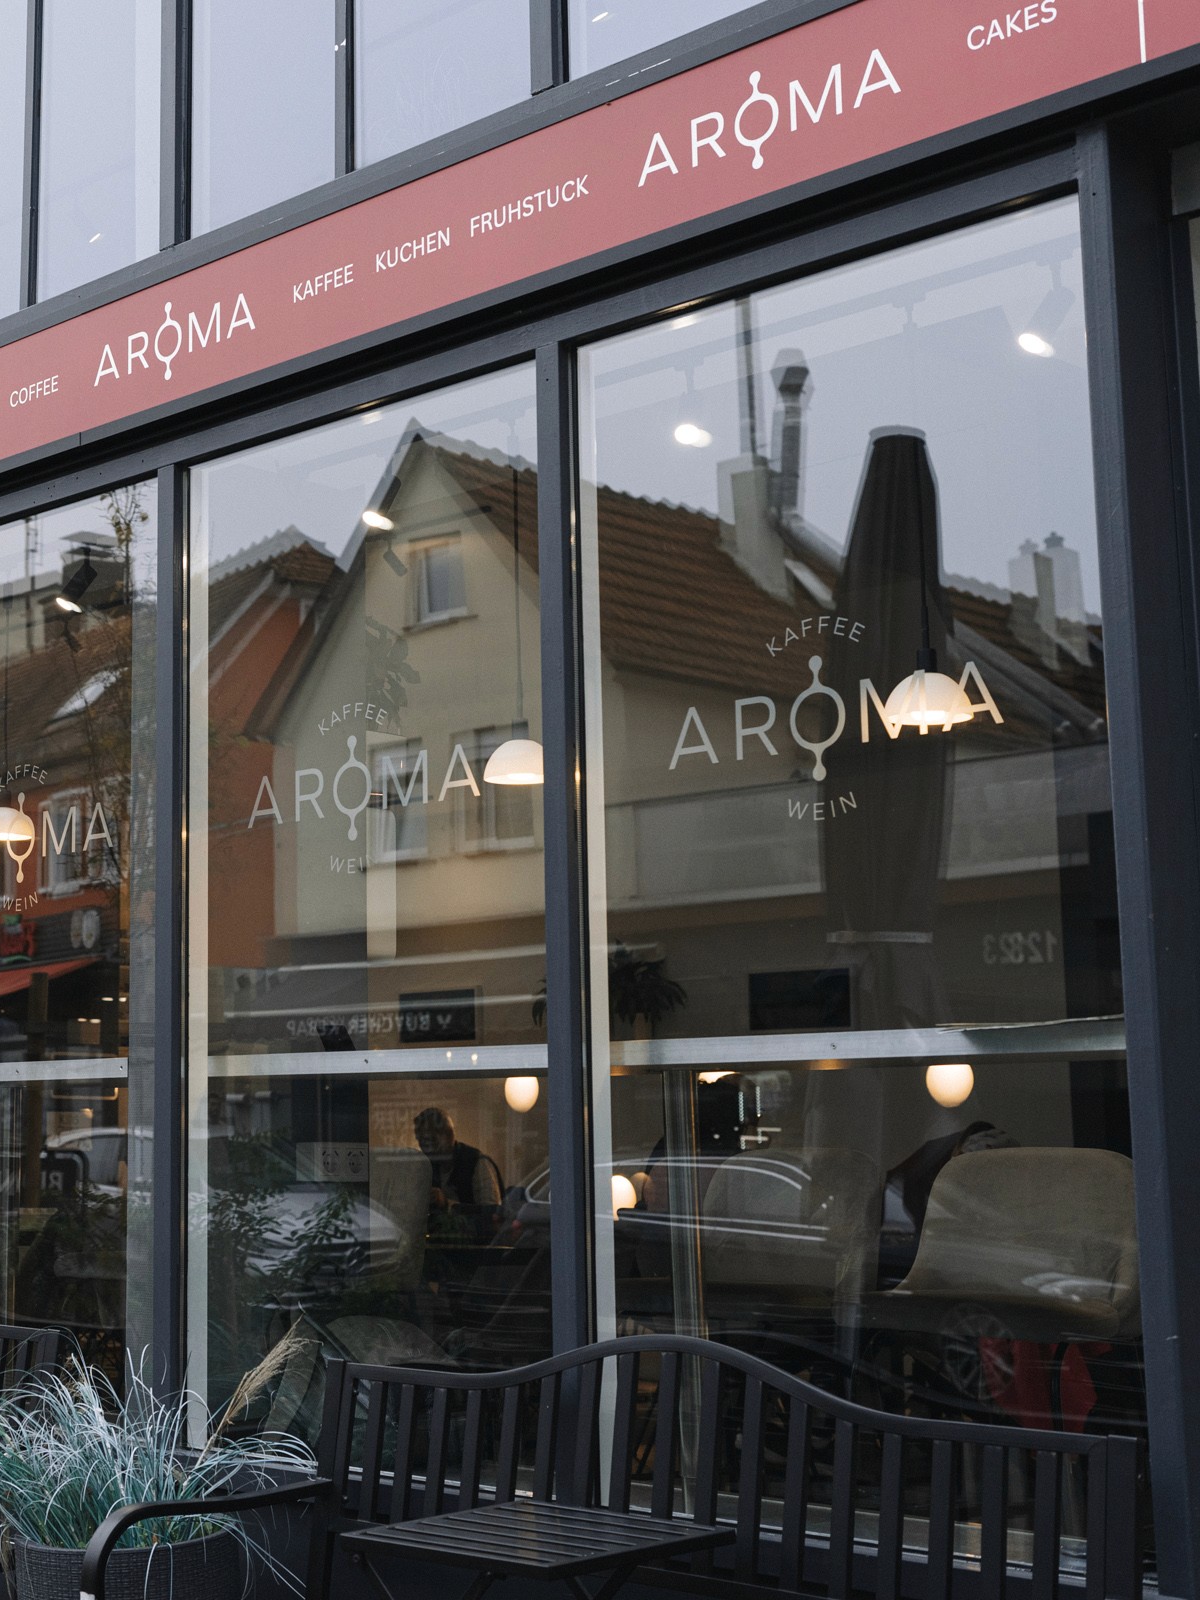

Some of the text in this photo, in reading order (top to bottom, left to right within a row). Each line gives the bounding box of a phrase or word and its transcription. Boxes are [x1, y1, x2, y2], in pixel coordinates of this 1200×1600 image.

[9, 375, 59, 408] COFFEE
[94, 293, 256, 387] AROMA
[293, 264, 354, 303] KAFFEE
[375, 228, 450, 272] KUCHEN
[470, 175, 589, 237] FRUHSTUCK
[637, 48, 902, 187] AROMA
[967, 0, 1057, 50] CAKES
[766, 615, 865, 657] KAFFEE
[317, 702, 388, 736] KAFFEE
[669, 655, 1004, 782] AROMA
[247, 735, 481, 841] AROMA
[787, 791, 858, 821] WEIN
[3, 891, 39, 912] WEIN
